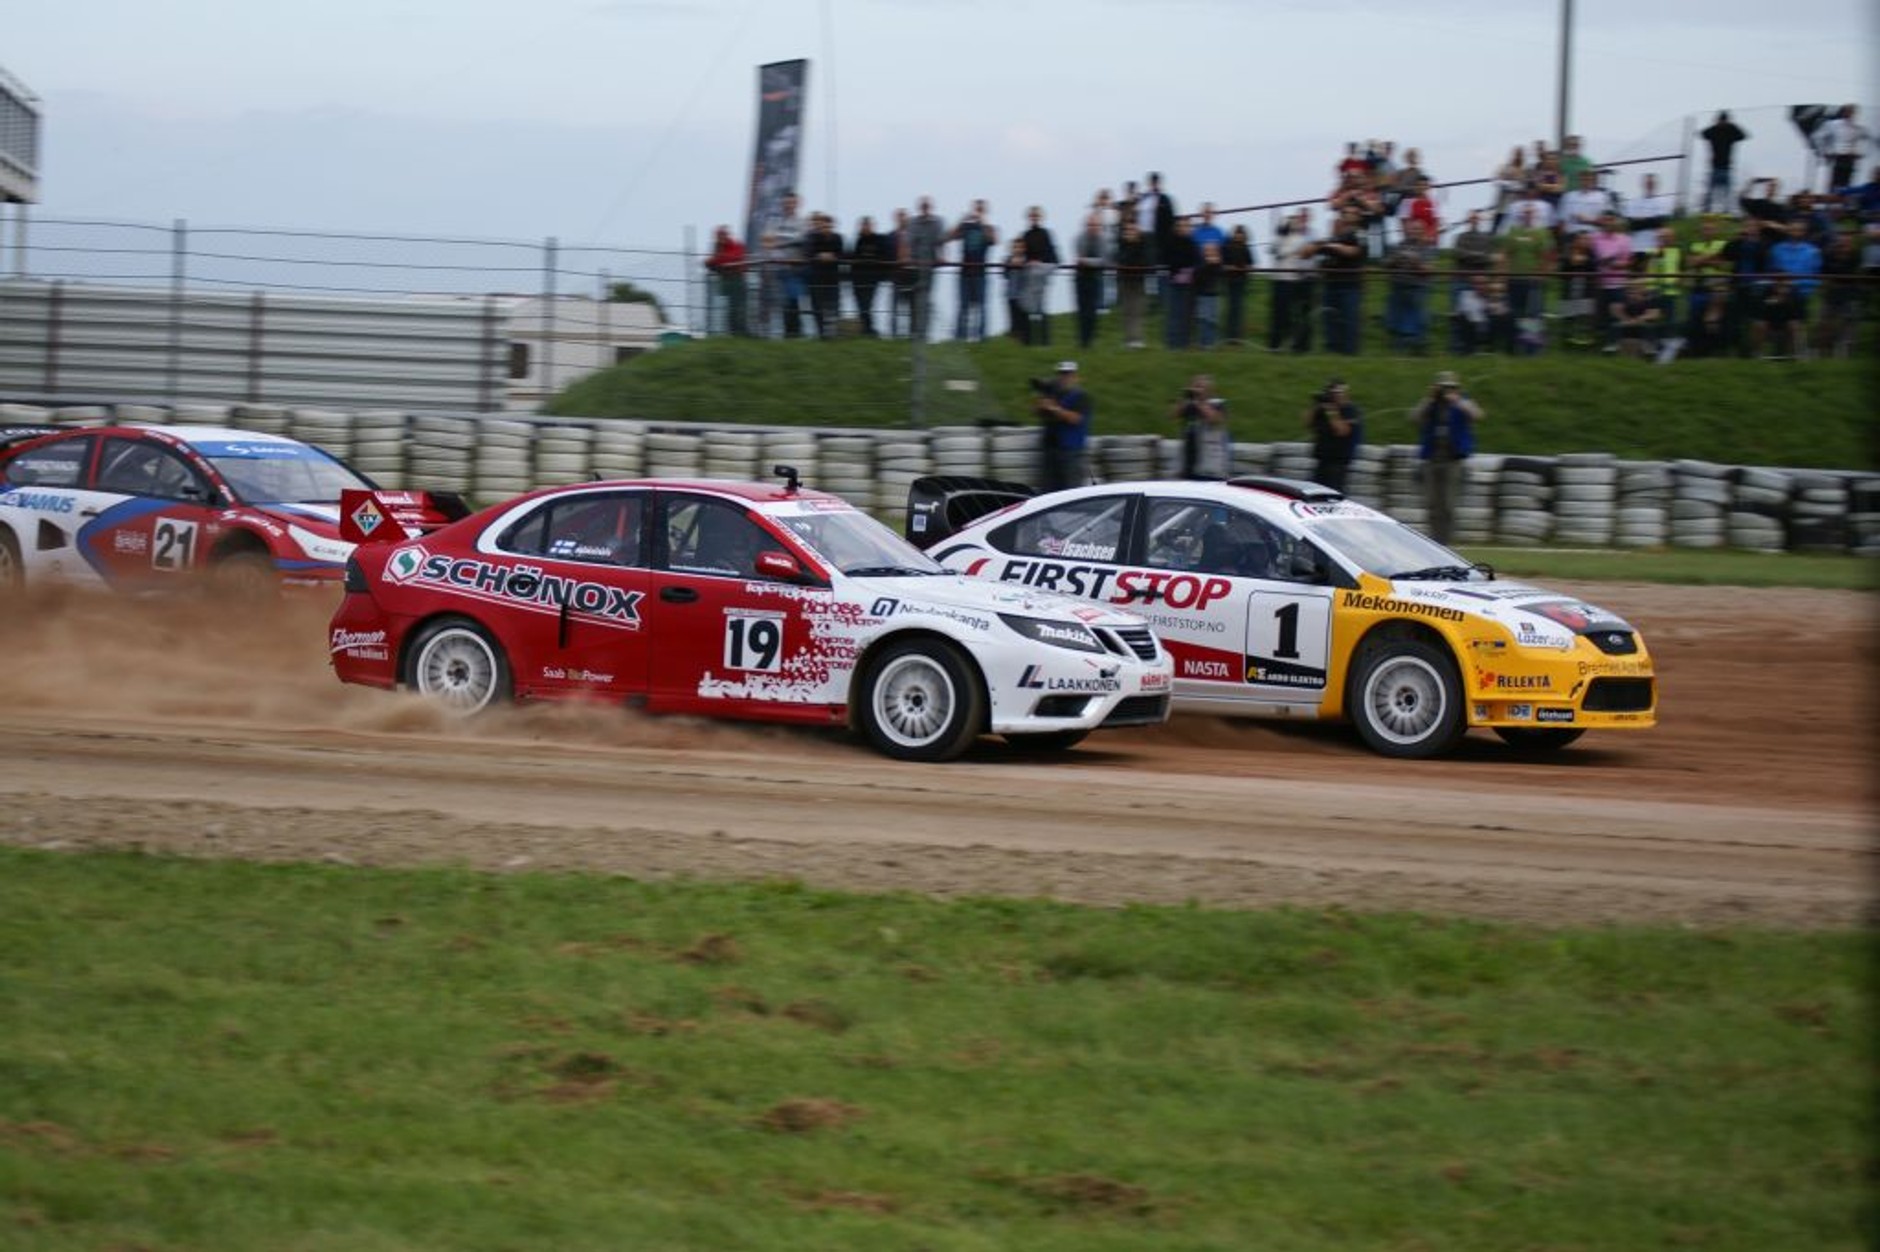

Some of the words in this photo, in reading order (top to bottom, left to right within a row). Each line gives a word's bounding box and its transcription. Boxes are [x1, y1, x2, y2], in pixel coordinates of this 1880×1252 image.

[155, 523, 194, 568] 21
[1062, 537, 1117, 560] Isachsen
[422, 556, 645, 621] SCHÖNOX
[1343, 592, 1466, 622] Mekonomen
[729, 619, 780, 669] 19
[1272, 602, 1300, 660] 1
[543, 667, 565, 679] Saab
[1184, 660, 1230, 677] NASTA
[1497, 675, 1551, 688] RELEKTA
[1048, 677, 1120, 691] LAAKKONEN
